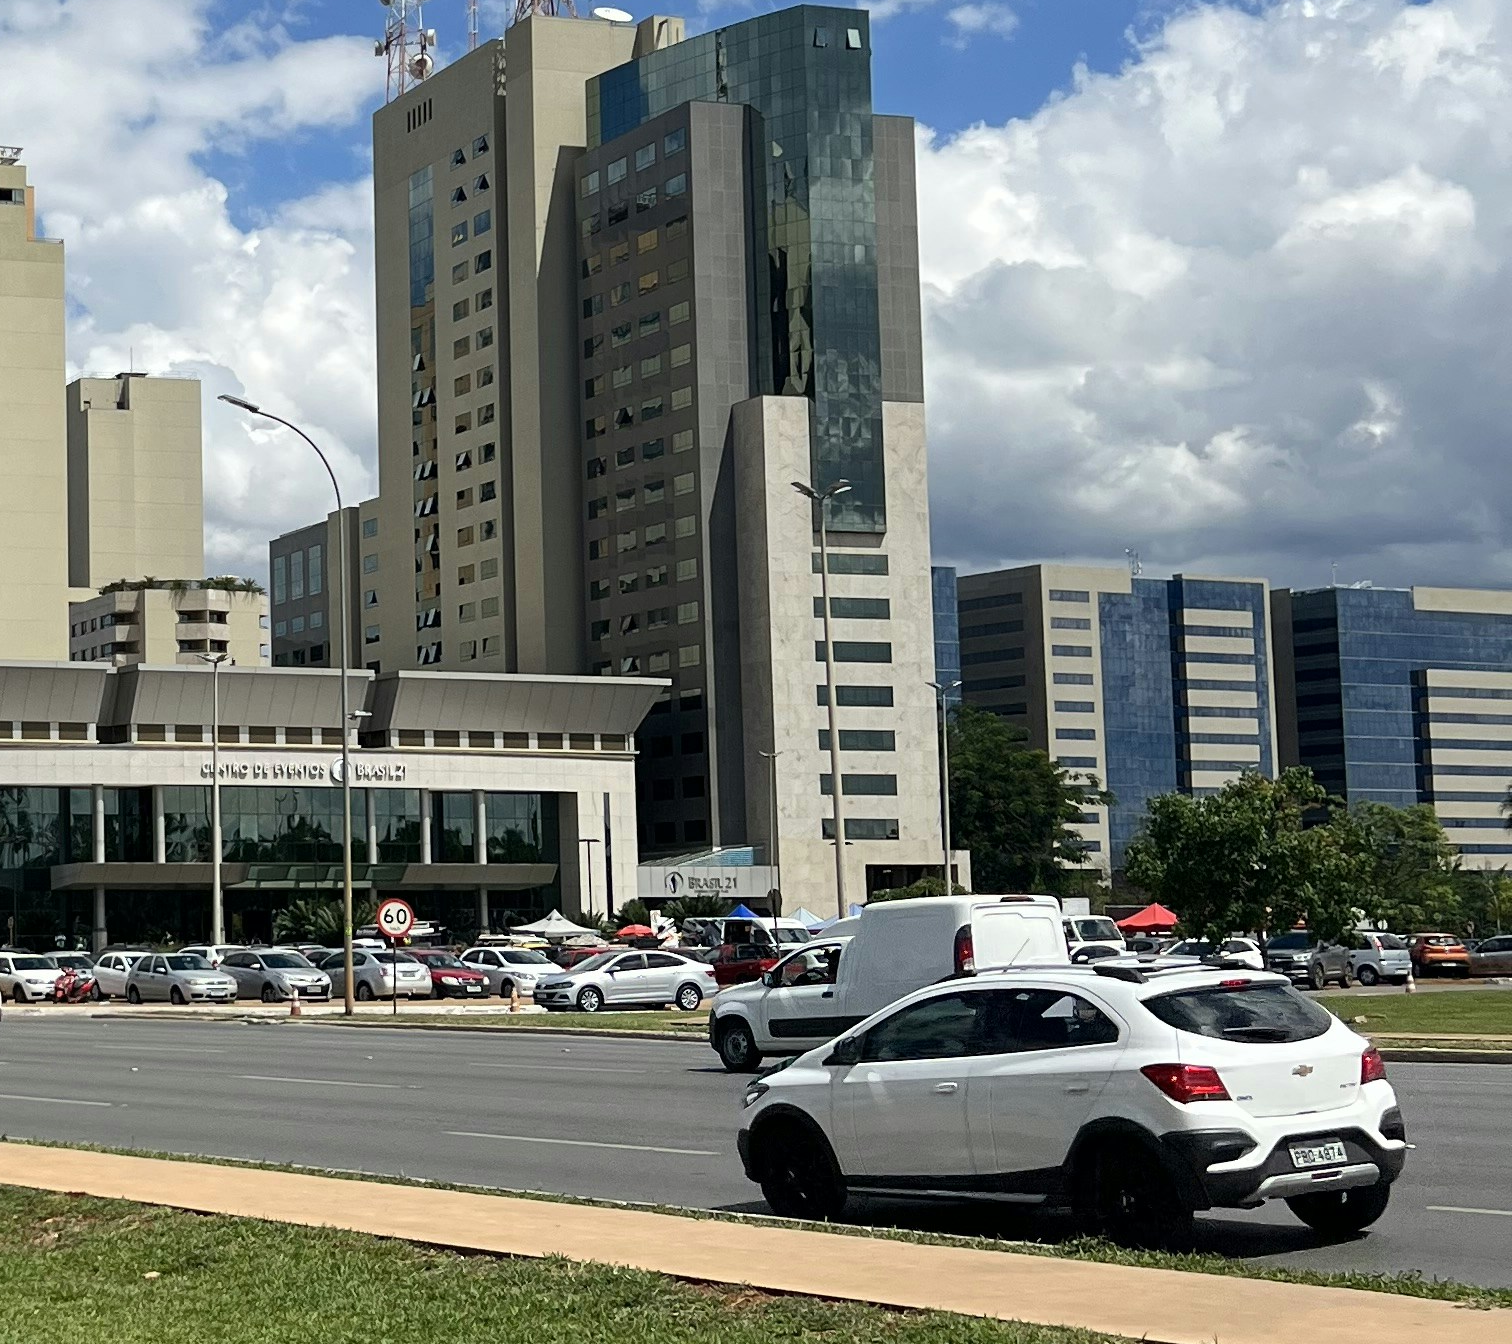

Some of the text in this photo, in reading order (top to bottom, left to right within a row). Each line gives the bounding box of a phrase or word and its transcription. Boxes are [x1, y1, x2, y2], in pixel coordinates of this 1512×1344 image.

[254, 763, 269, 778] DE
[274, 763, 326, 779] EVENTOS
[356, 763, 394, 780] BRASIL
[688, 877, 737, 889] BRASIL 21
[384, 908, 407, 924] 60
